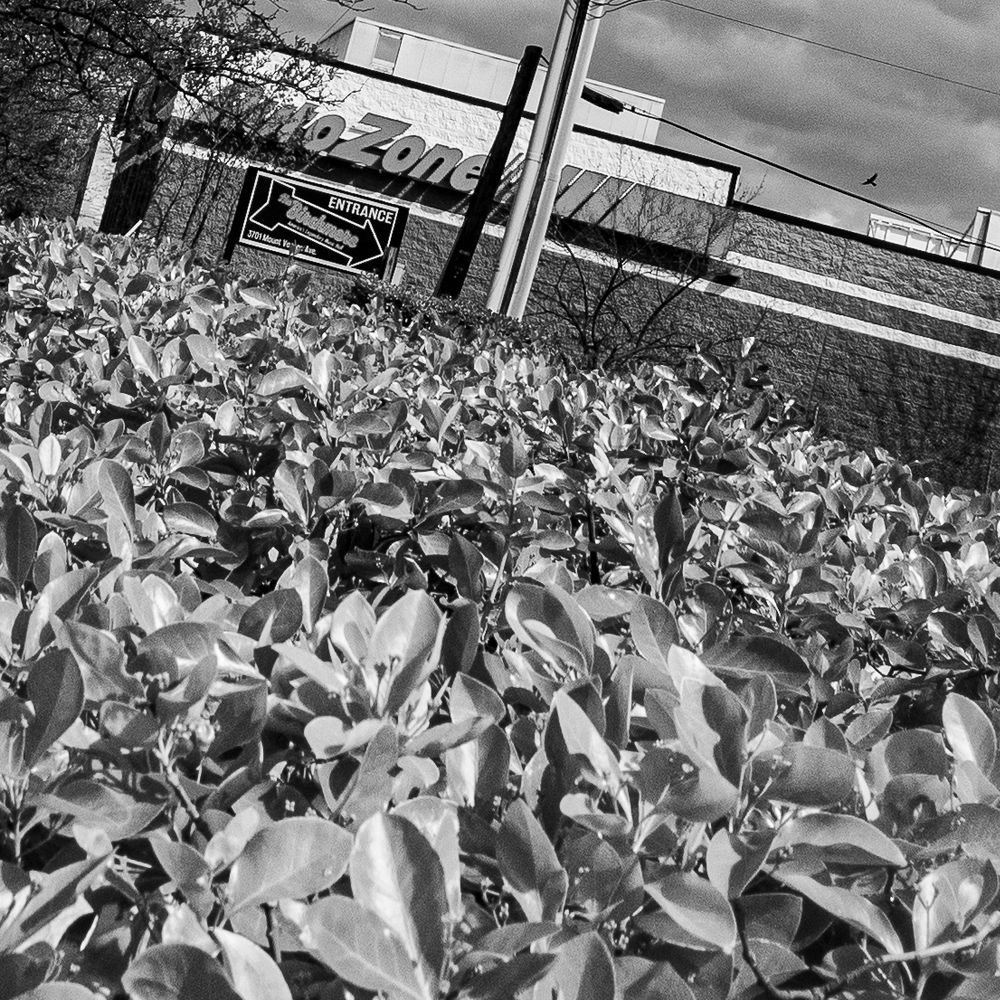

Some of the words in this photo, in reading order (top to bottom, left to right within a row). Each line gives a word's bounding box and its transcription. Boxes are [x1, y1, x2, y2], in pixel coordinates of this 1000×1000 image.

[286, 200, 359, 248] Birchmere
[328, 196, 394, 225] ENTRANCE
[247, 229, 262, 240] 3701
[262, 233, 282, 246] Mount
